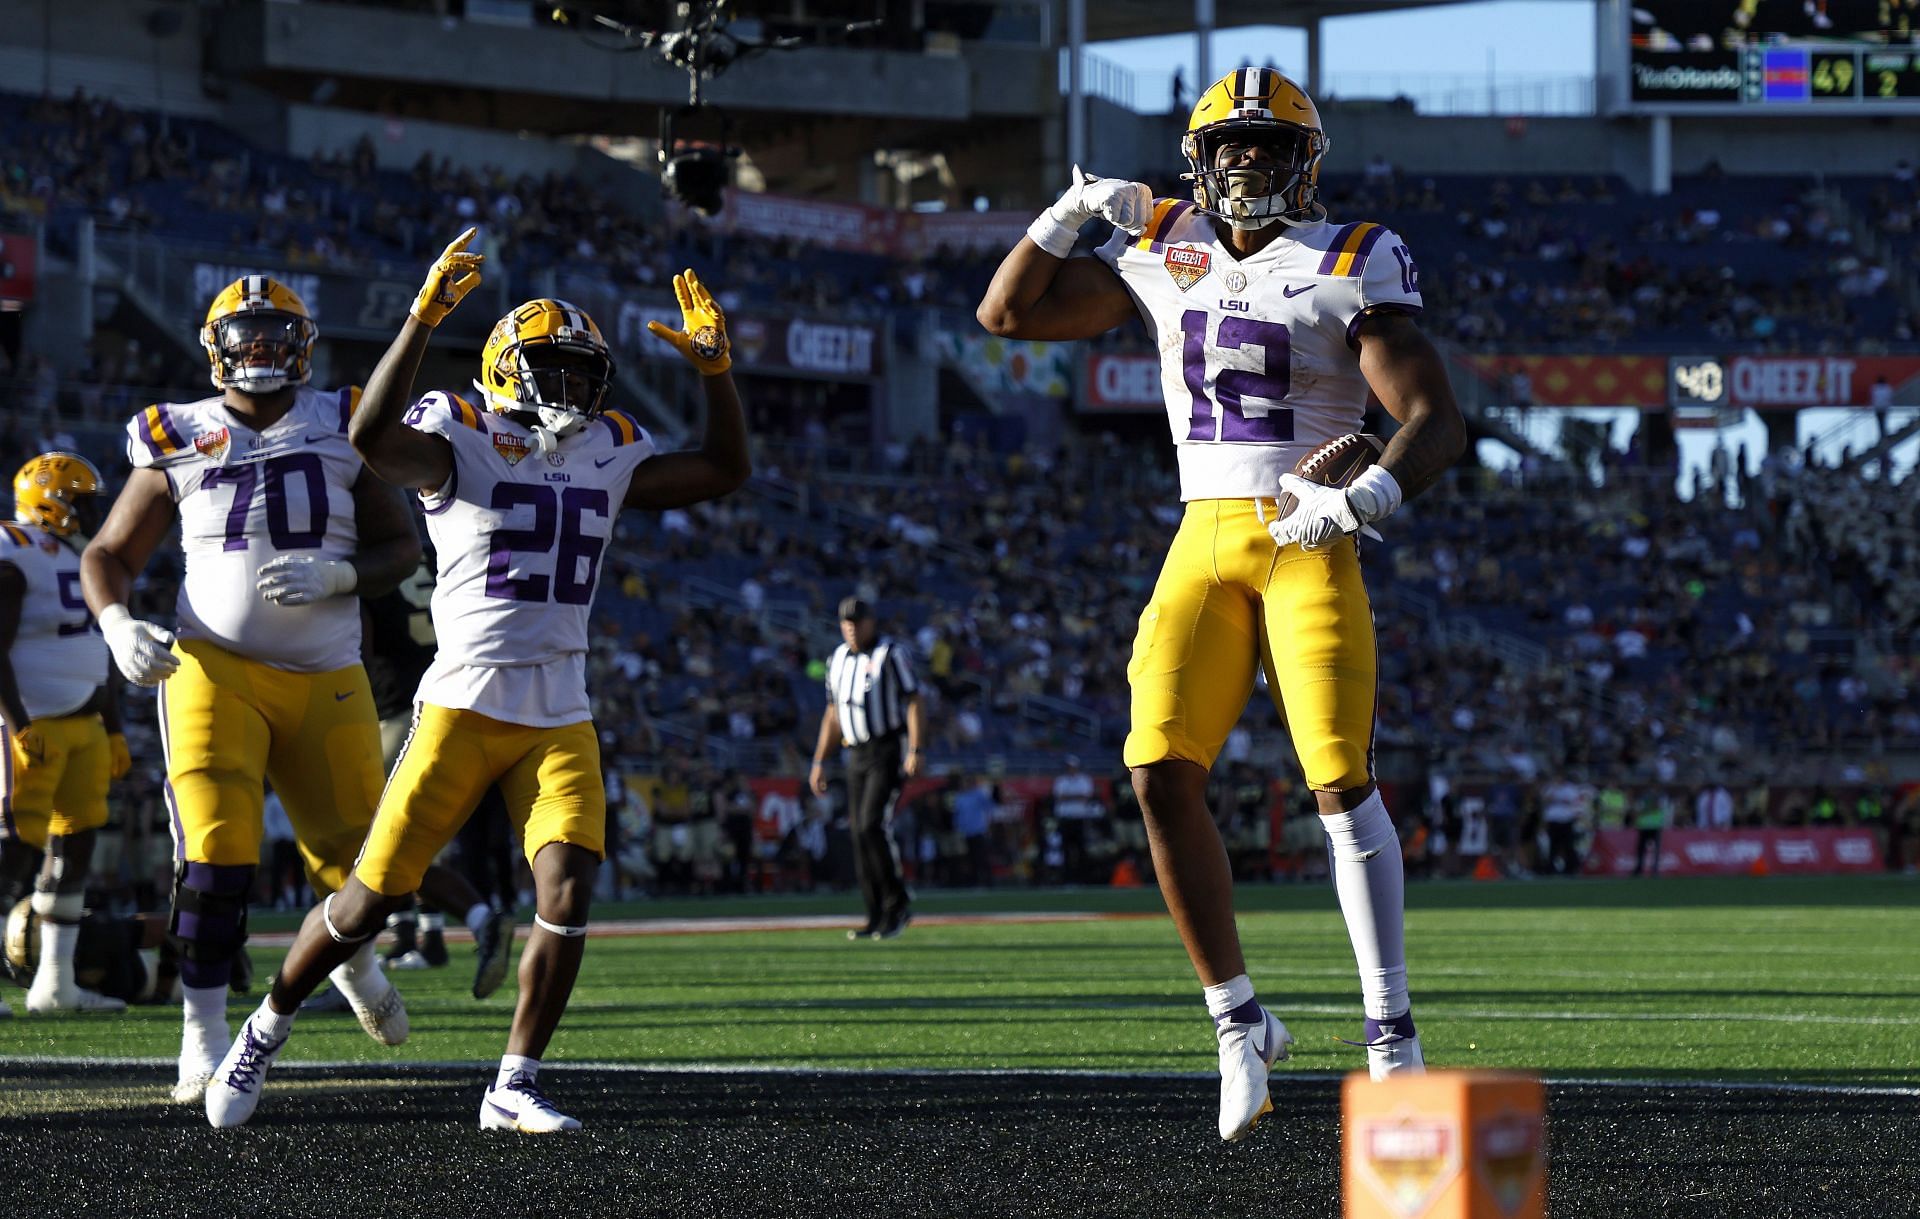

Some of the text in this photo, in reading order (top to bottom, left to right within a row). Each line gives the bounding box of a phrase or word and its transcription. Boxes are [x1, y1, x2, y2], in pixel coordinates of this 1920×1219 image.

[1219, 299, 1249, 312] LSU
[1181, 309, 1295, 442] 12
[201, 453, 330, 552] 70
[544, 472, 571, 482] LSU
[485, 481, 609, 605] 26
